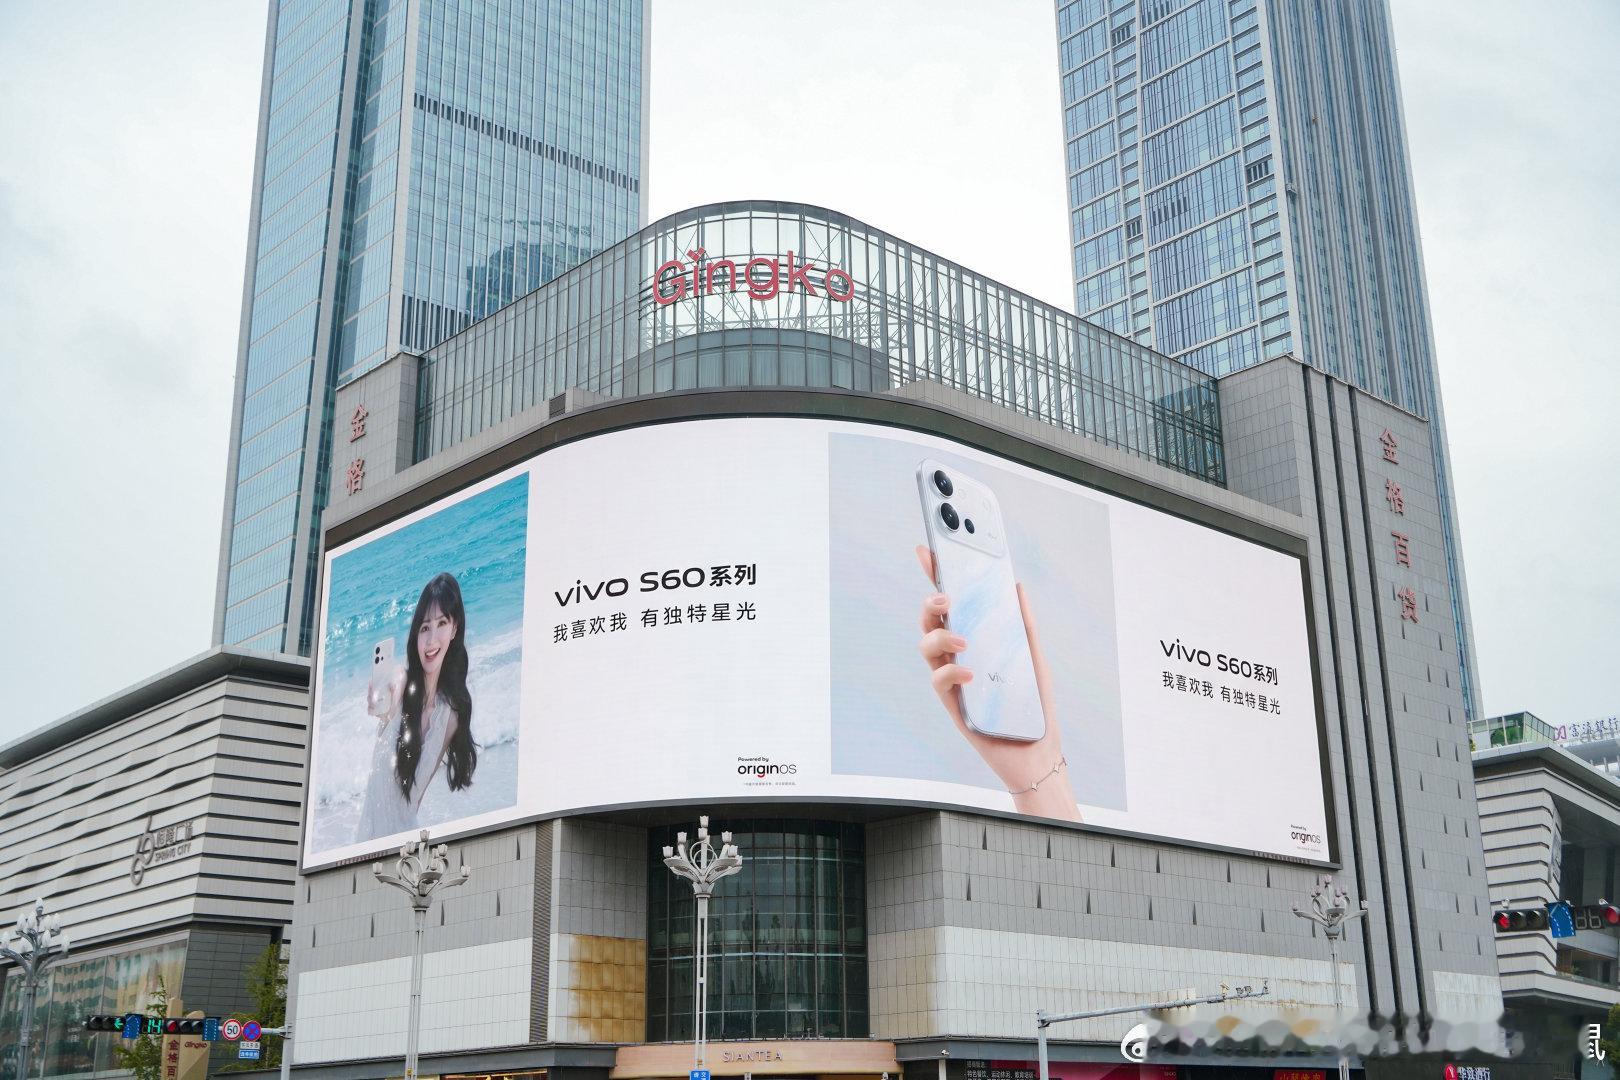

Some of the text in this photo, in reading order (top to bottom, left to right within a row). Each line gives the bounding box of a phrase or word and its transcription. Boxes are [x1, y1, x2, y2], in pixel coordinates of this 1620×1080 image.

[653, 247, 855, 306] Gingko
[1379, 428, 1419, 624] 金格百货
[554, 564, 757, 607] vivo S60系列
[553, 602, 757, 644] 我喜欢我 有独特星光
[1160, 639, 1278, 686] vivo S60系列
[1162, 671, 1281, 715] 我喜欢我 有独特星光
[177, 842, 191, 855] CITY
[184, 1041, 208, 1049] Gingko
[226, 1025, 238, 1035] 50
[167, 1040, 180, 1080] 金格百
[722, 1050, 783, 1063] SIANTEA
